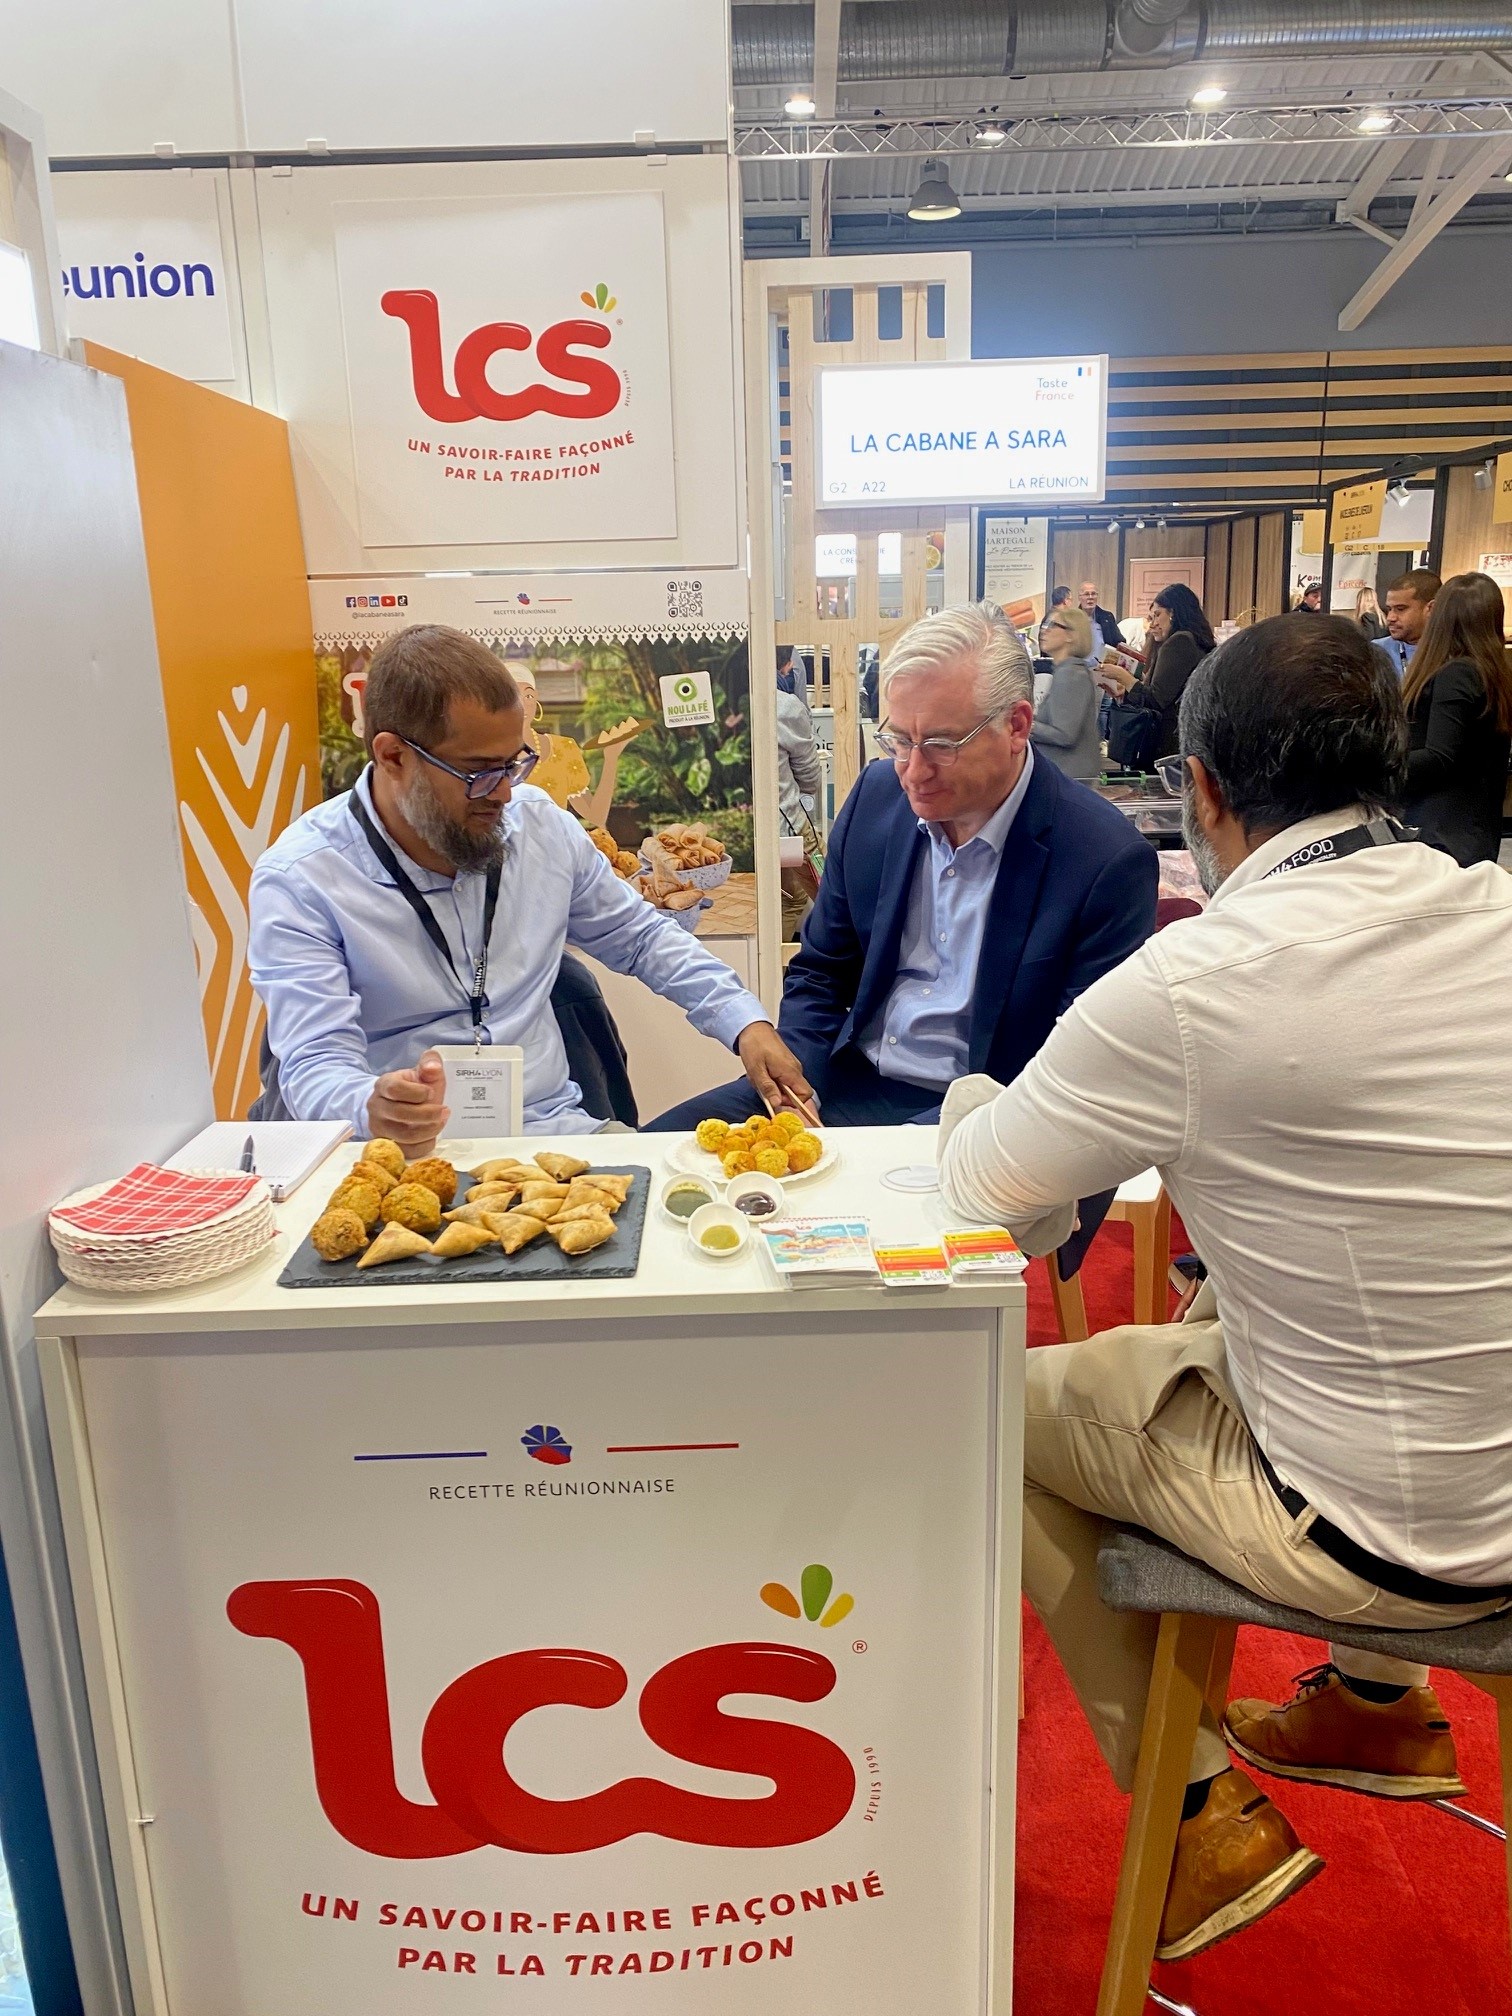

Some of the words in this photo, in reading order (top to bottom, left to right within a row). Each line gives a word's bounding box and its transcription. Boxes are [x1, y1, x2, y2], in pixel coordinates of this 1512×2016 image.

[1037, 377, 1068, 389] Taste
[1035, 390, 1075, 401] France
[407, 438, 431, 454] UN
[437, 444, 553, 461] SAVOIR-FAIRE
[559, 430, 635, 459] FAÇONNÉ
[851, 434, 879, 453] LA
[886, 431, 977, 452] CABANE
[985, 431, 1000, 450] A
[1007, 429, 1067, 449] SARA
[444, 466, 477, 480] PAR
[483, 470, 504, 482] LA
[510, 462, 601, 482] TRADITION
[1009, 477, 1026, 489] LA
[1030, 474, 1089, 489] RÉUNION
[829, 482, 847, 494] G2
[862, 481, 886, 493] A22
[991, 527, 1026, 535] MAISON
[668, 704, 684, 716] NOU
[686, 703, 697, 714] LA
[698, 699, 709, 713] FÉ
[429, 1484, 515, 1500] RECETTE
[525, 1479, 675, 1497] RÉUNIONNAISE
[863, 1747, 880, 1774] 1990
[863, 1781, 882, 1822] DEPUIS
[301, 1893, 359, 1921] UN
[379, 1903, 672, 1934] SAVOIR-FAIRE
[691, 1870, 884, 1926] FAÇONNÉ
[398, 1947, 476, 1974] PAR
[497, 1954, 545, 1976] LA
[565, 1935, 794, 1976] TRADITION
